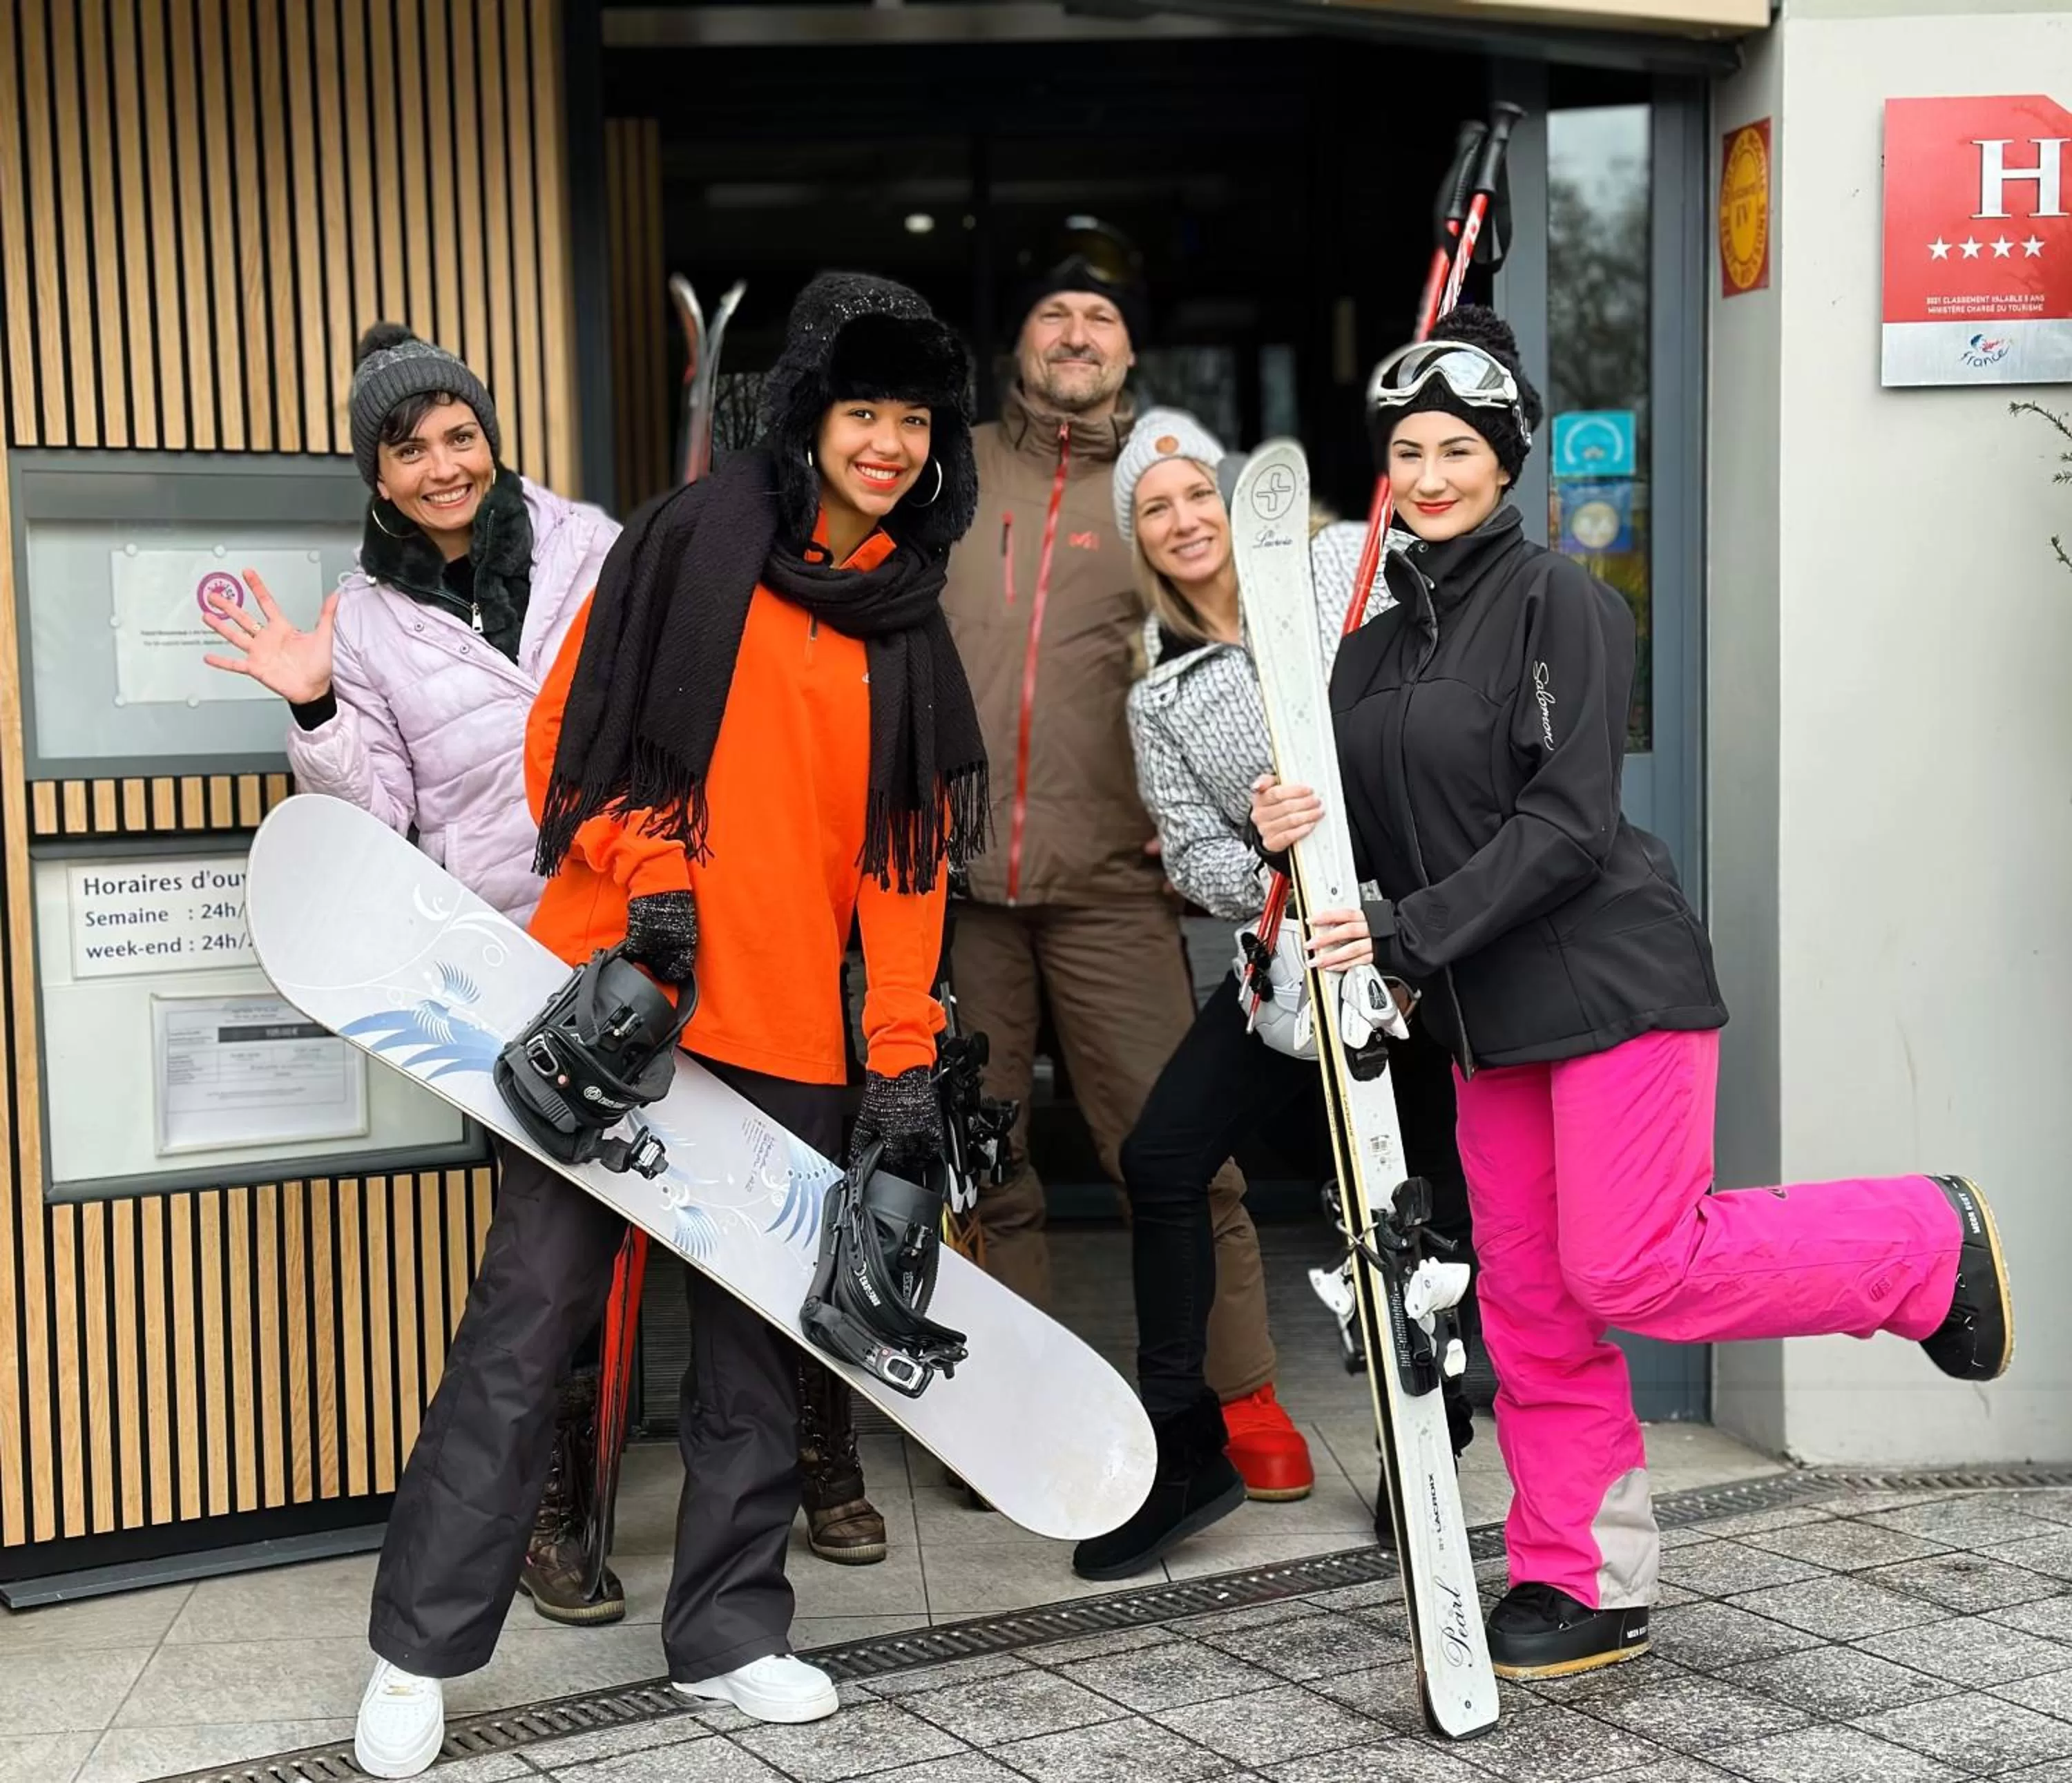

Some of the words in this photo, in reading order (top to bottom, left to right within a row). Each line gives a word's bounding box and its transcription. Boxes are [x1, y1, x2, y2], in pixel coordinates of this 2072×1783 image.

[1971, 138, 2071, 218] H
[1533, 659, 1555, 751] Salomon
[84, 874, 182, 896] Horaires
[86, 907, 169, 927] Semaine
[86, 937, 182, 959] week-end
[202, 932, 253, 951] 24h/
[1432, 1575, 1474, 1668] Pearl
